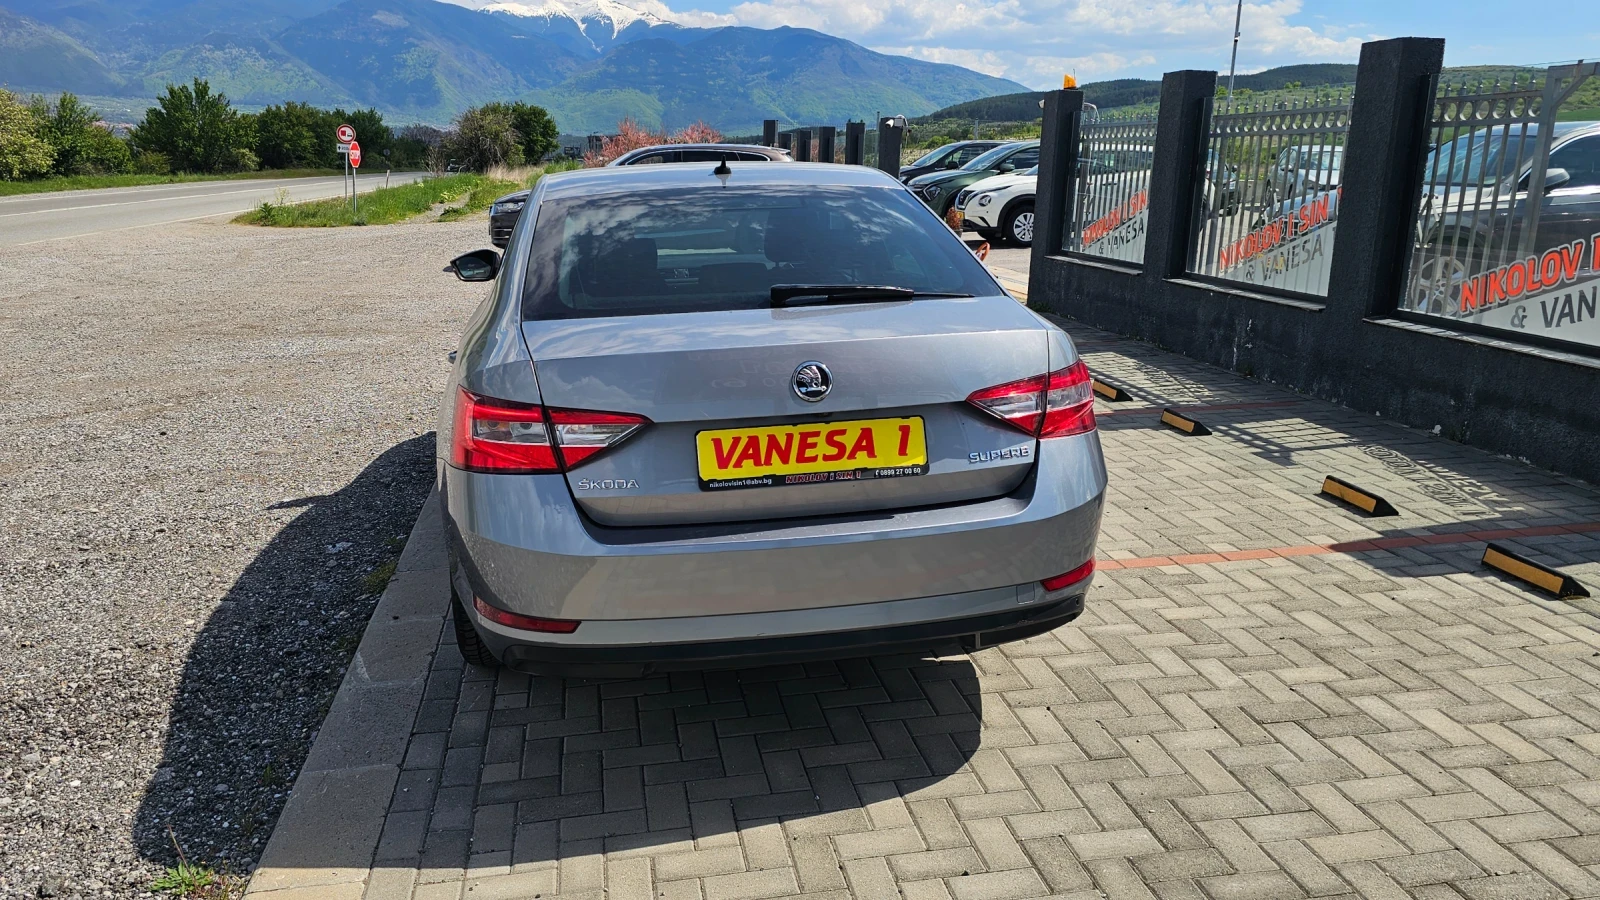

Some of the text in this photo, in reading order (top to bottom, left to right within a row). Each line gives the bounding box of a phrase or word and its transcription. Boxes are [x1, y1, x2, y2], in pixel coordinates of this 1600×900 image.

[1130, 187, 1147, 217] SIN
[1108, 217, 1144, 253] VANESA
[1220, 215, 1283, 272] NIKOLOV
[1299, 192, 1329, 233] SIN
[1261, 233, 1323, 281] VANESA
[1460, 240, 1584, 313] NIKOLOV
[1510, 286, 1598, 328] & VAN
[711, 427, 877, 470] VANESA
[968, 445, 1031, 463] SUPERB
[578, 478, 640, 490] ŠKODA
[709, 478, 772, 488] nikolovisin1@abv.bg
[786, 473, 829, 484] NIKOLOV
